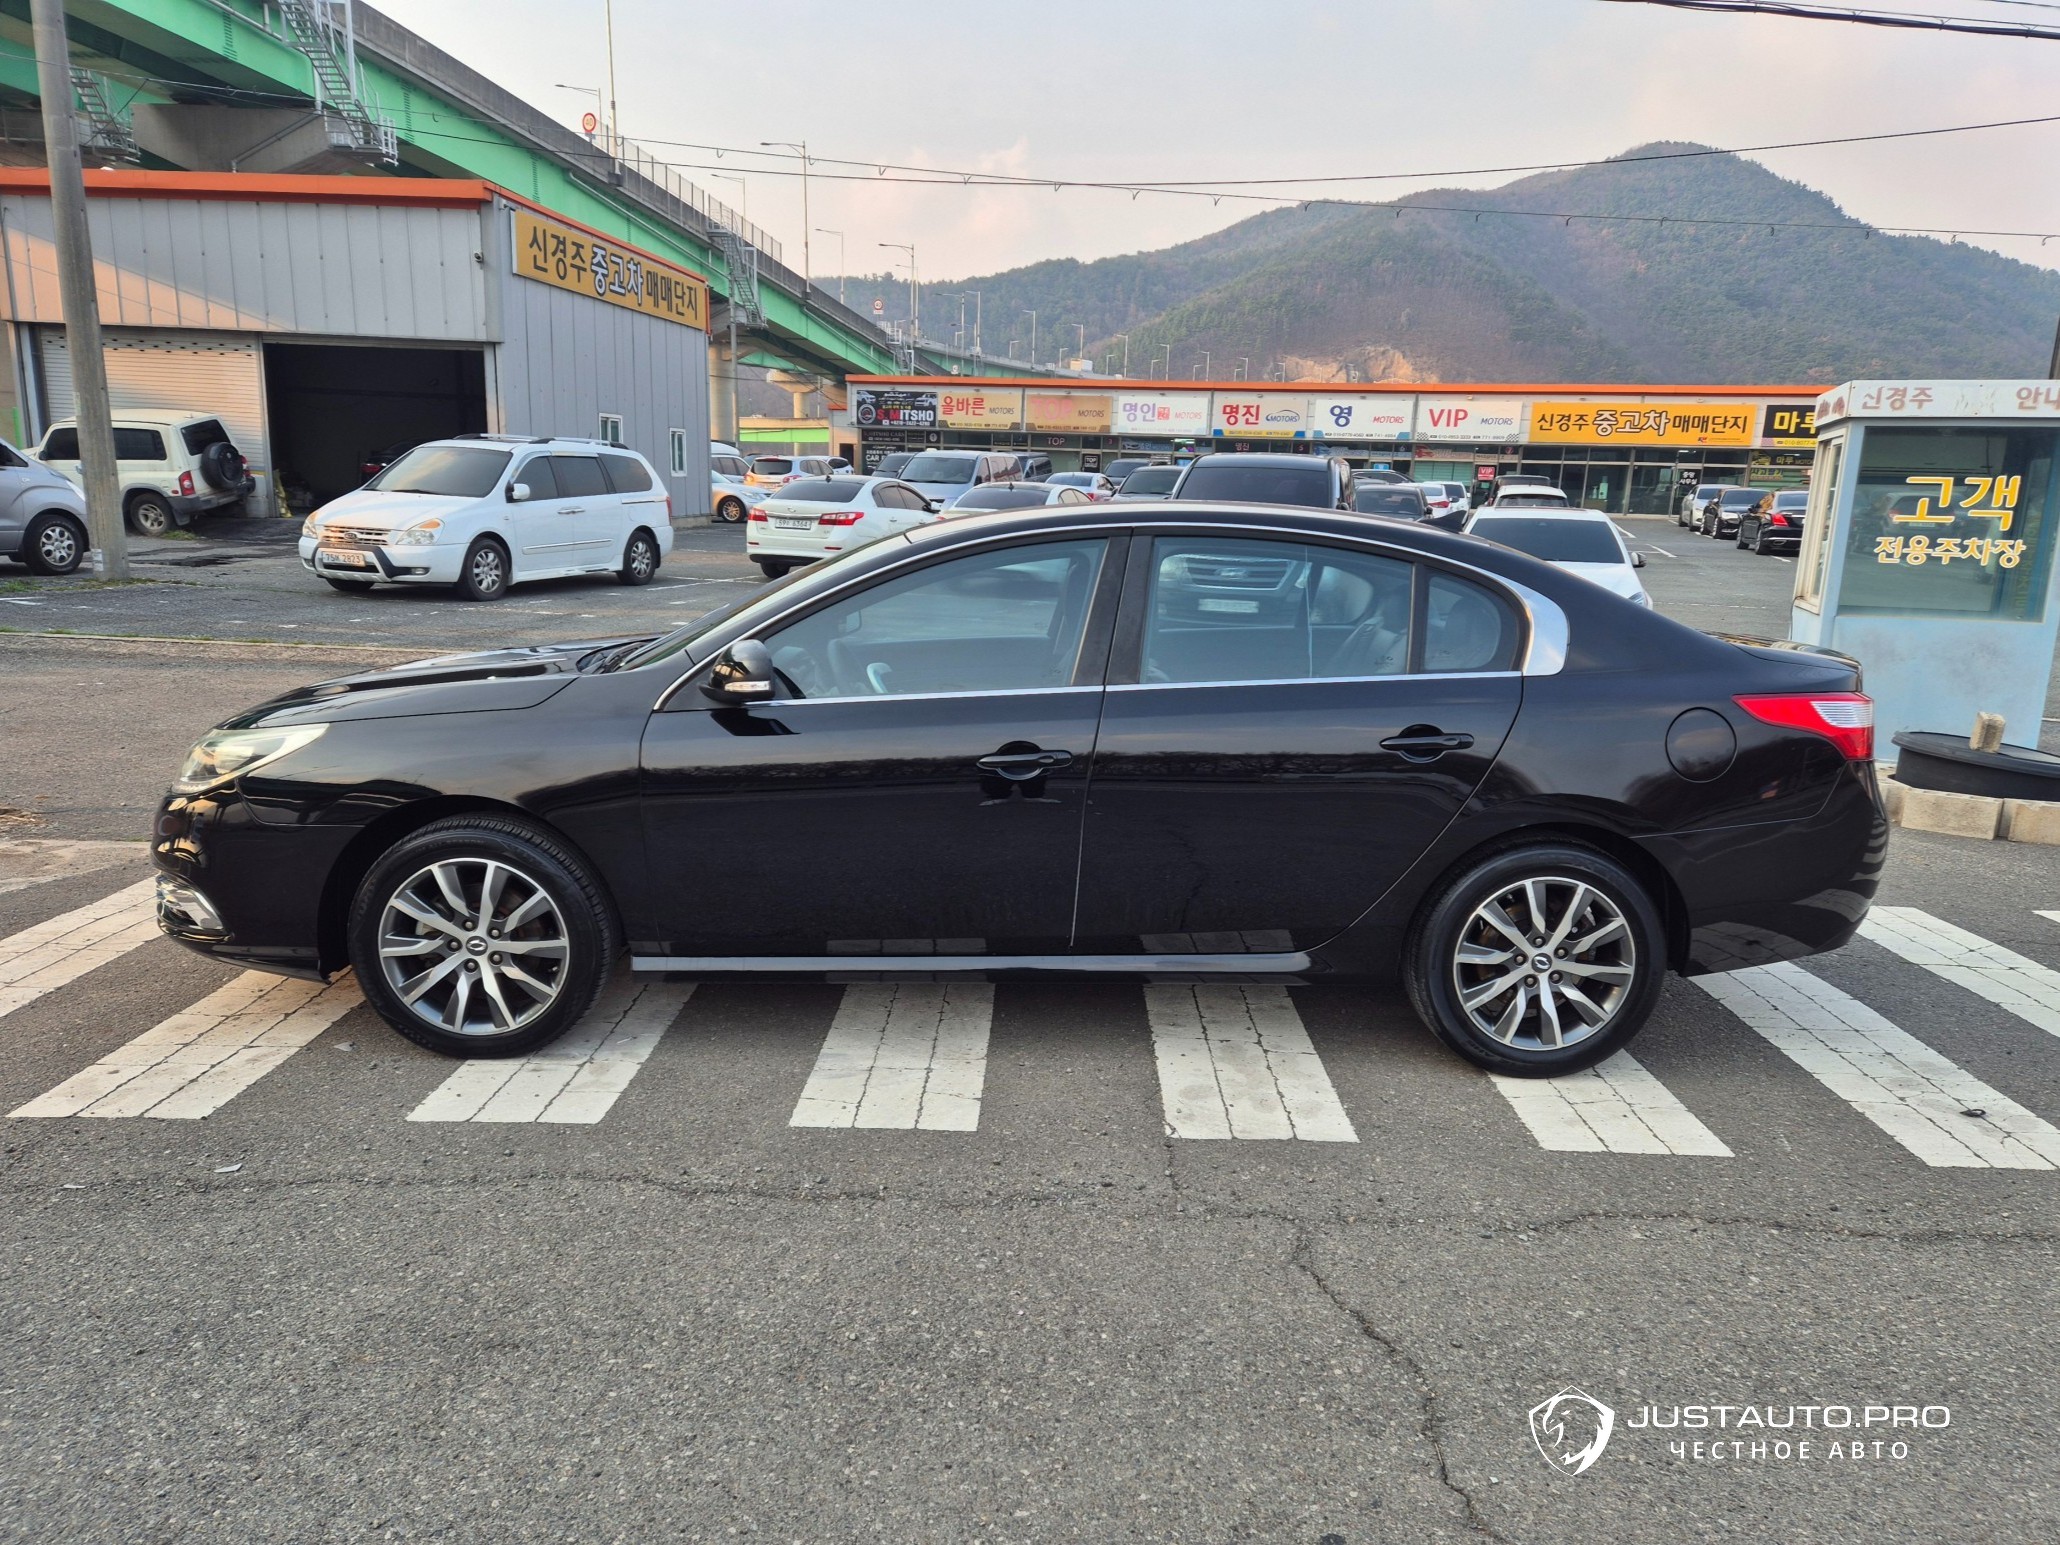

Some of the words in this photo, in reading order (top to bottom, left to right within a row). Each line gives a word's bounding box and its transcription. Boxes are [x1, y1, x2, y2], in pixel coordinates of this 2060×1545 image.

[590, 243, 644, 307] 중고차
[941, 396, 986, 416] 올바른
[989, 407, 1015, 415] MOTORS
[1029, 397, 1073, 420] TOP
[1077, 409, 1105, 418] MOTORS
[1861, 386, 1934, 411] 신경주
[1122, 402, 1156, 423] 명인
[1174, 411, 1202, 420] MOTORS
[1222, 404, 1261, 426] 명진
[1329, 405, 1353, 427] 영
[1372, 415, 1405, 424] MOTORS
[1428, 408, 1469, 427] VIP
[1480, 417, 1514, 426] MOTORS
[1537, 413, 1590, 432] 신경주
[1592, 409, 1671, 437] 중고차
[1672, 415, 1748, 434] 매매단지
[1047, 437, 1066, 446] TOP
[1892, 475, 2022, 532] 고객
[1874, 534, 2027, 569] 전용주차장
